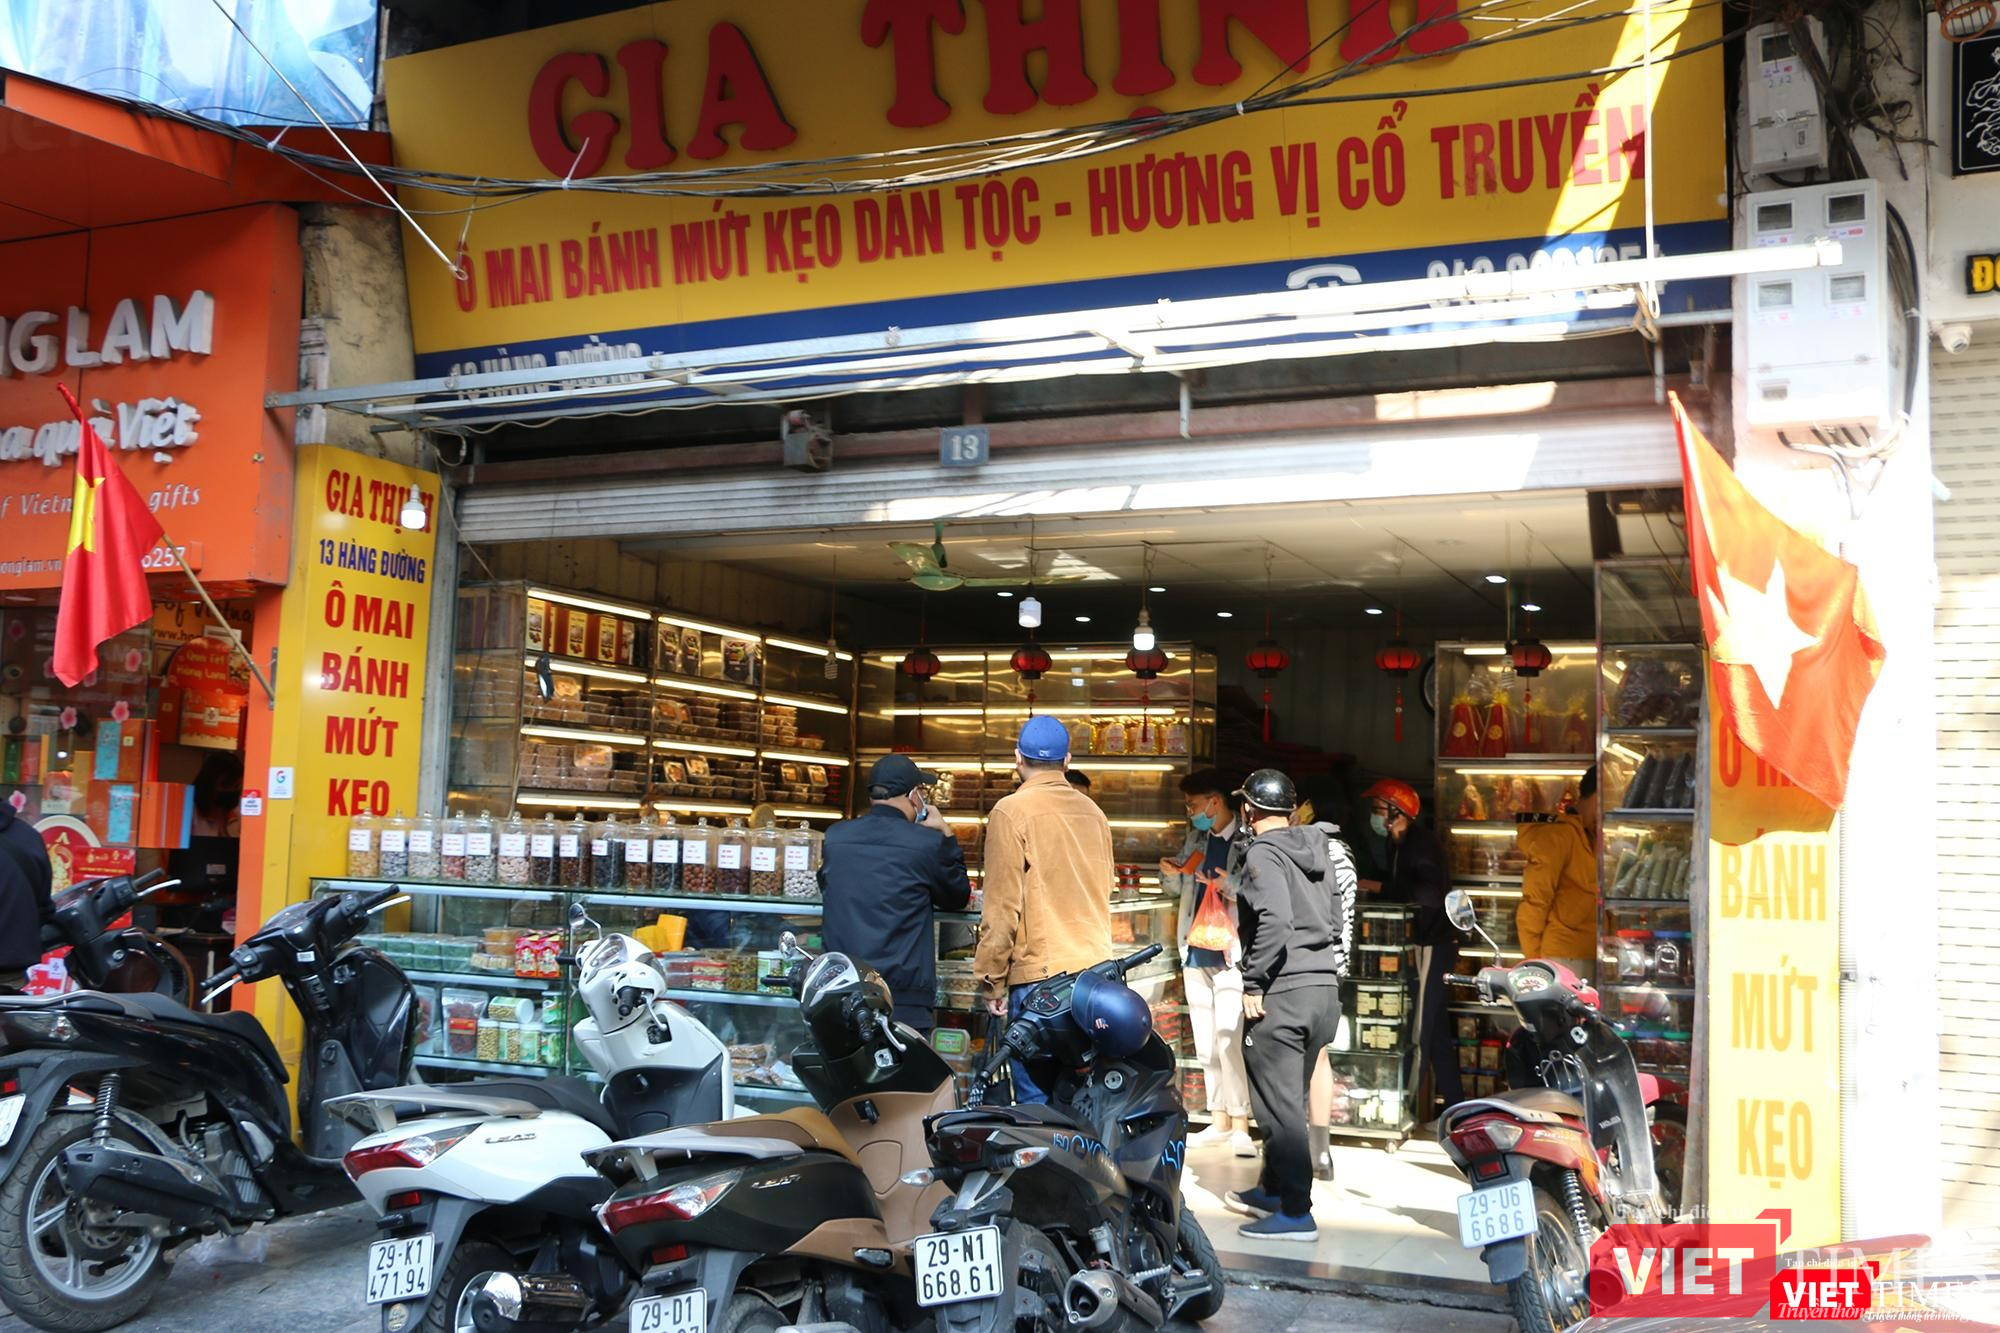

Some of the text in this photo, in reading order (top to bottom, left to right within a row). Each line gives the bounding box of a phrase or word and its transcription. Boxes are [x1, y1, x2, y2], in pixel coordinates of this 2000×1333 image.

[528, 20, 798, 180] GIA
[484, 242, 553, 309] MAI
[559, 221, 662, 300] BÁNH
[670, 199, 752, 286] MỨT
[764, 203, 843, 284] KẸO
[954, 171, 1041, 263] TỘC
[1087, 149, 1255, 238] HƯƠNG
[1270, 141, 1322, 229] VỊ
[1336, 99, 1409, 211] CỔ
[1429, 82, 1647, 201] TRUYỀN
[117, 397, 201, 464] Việt
[951, 434, 980, 461] 13
[149, 484, 200, 513] gifts
[326, 469, 364, 519] GIA
[320, 538, 425, 584] 13 HÀNG ĐƯỜNG
[325, 580, 415, 640] Ô MAI
[322, 645, 409, 699] BÁNH
[325, 706, 399, 758] MỨT
[1721, 828, 1825, 921] BÁNH
[1731, 955, 1818, 1053] MỨT
[1738, 1098, 1813, 1189] KẸO
[1468, 1191, 1522, 1218] 29-U6
[1471, 1211, 1525, 1242] 6686
[377, 1238, 423, 1271] 29-K1
[927, 1233, 985, 1266] 29-N1
[370, 1272, 426, 1299] 471.94
[923, 1265, 995, 1300] 668.61
[641, 1296, 692, 1331] 29-D1
